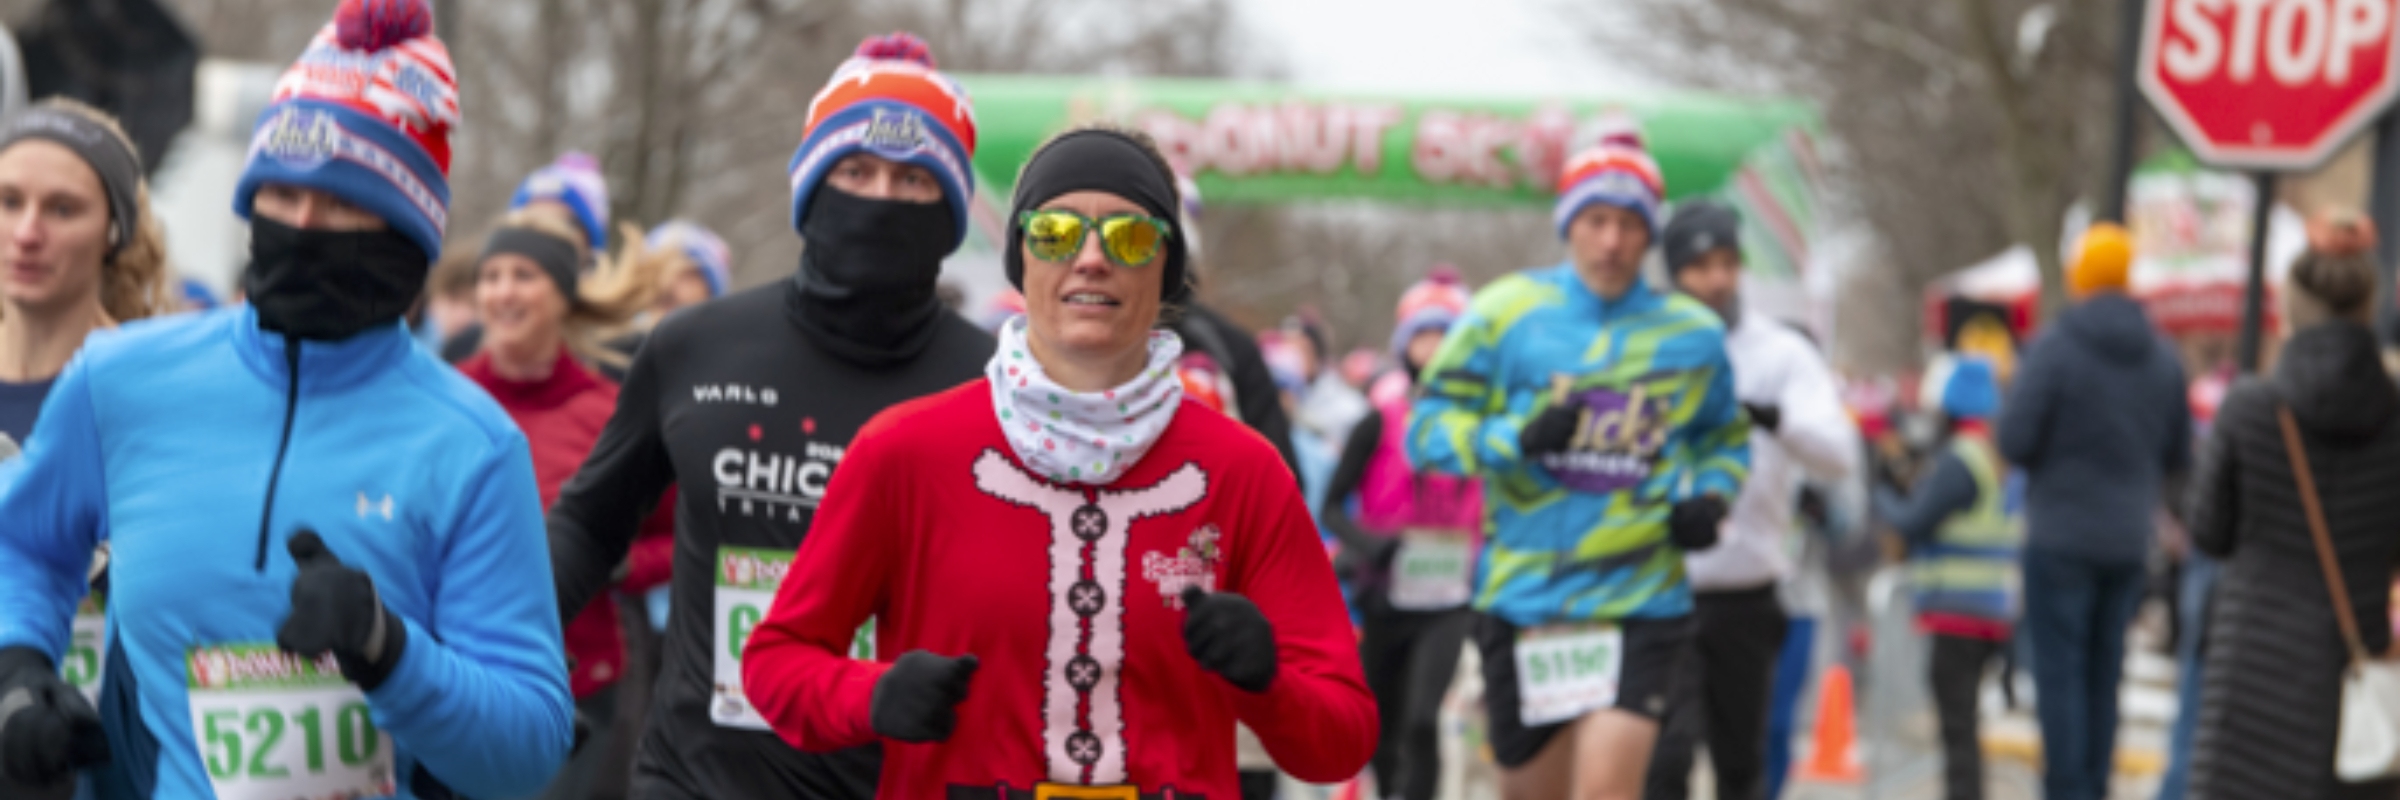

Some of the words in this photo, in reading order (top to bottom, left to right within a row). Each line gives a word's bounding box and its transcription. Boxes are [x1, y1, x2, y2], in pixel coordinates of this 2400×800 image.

[2163, 0, 2388, 86] STOP
[713, 447, 830, 498] CHIC
[203, 703, 379, 780] 5210
